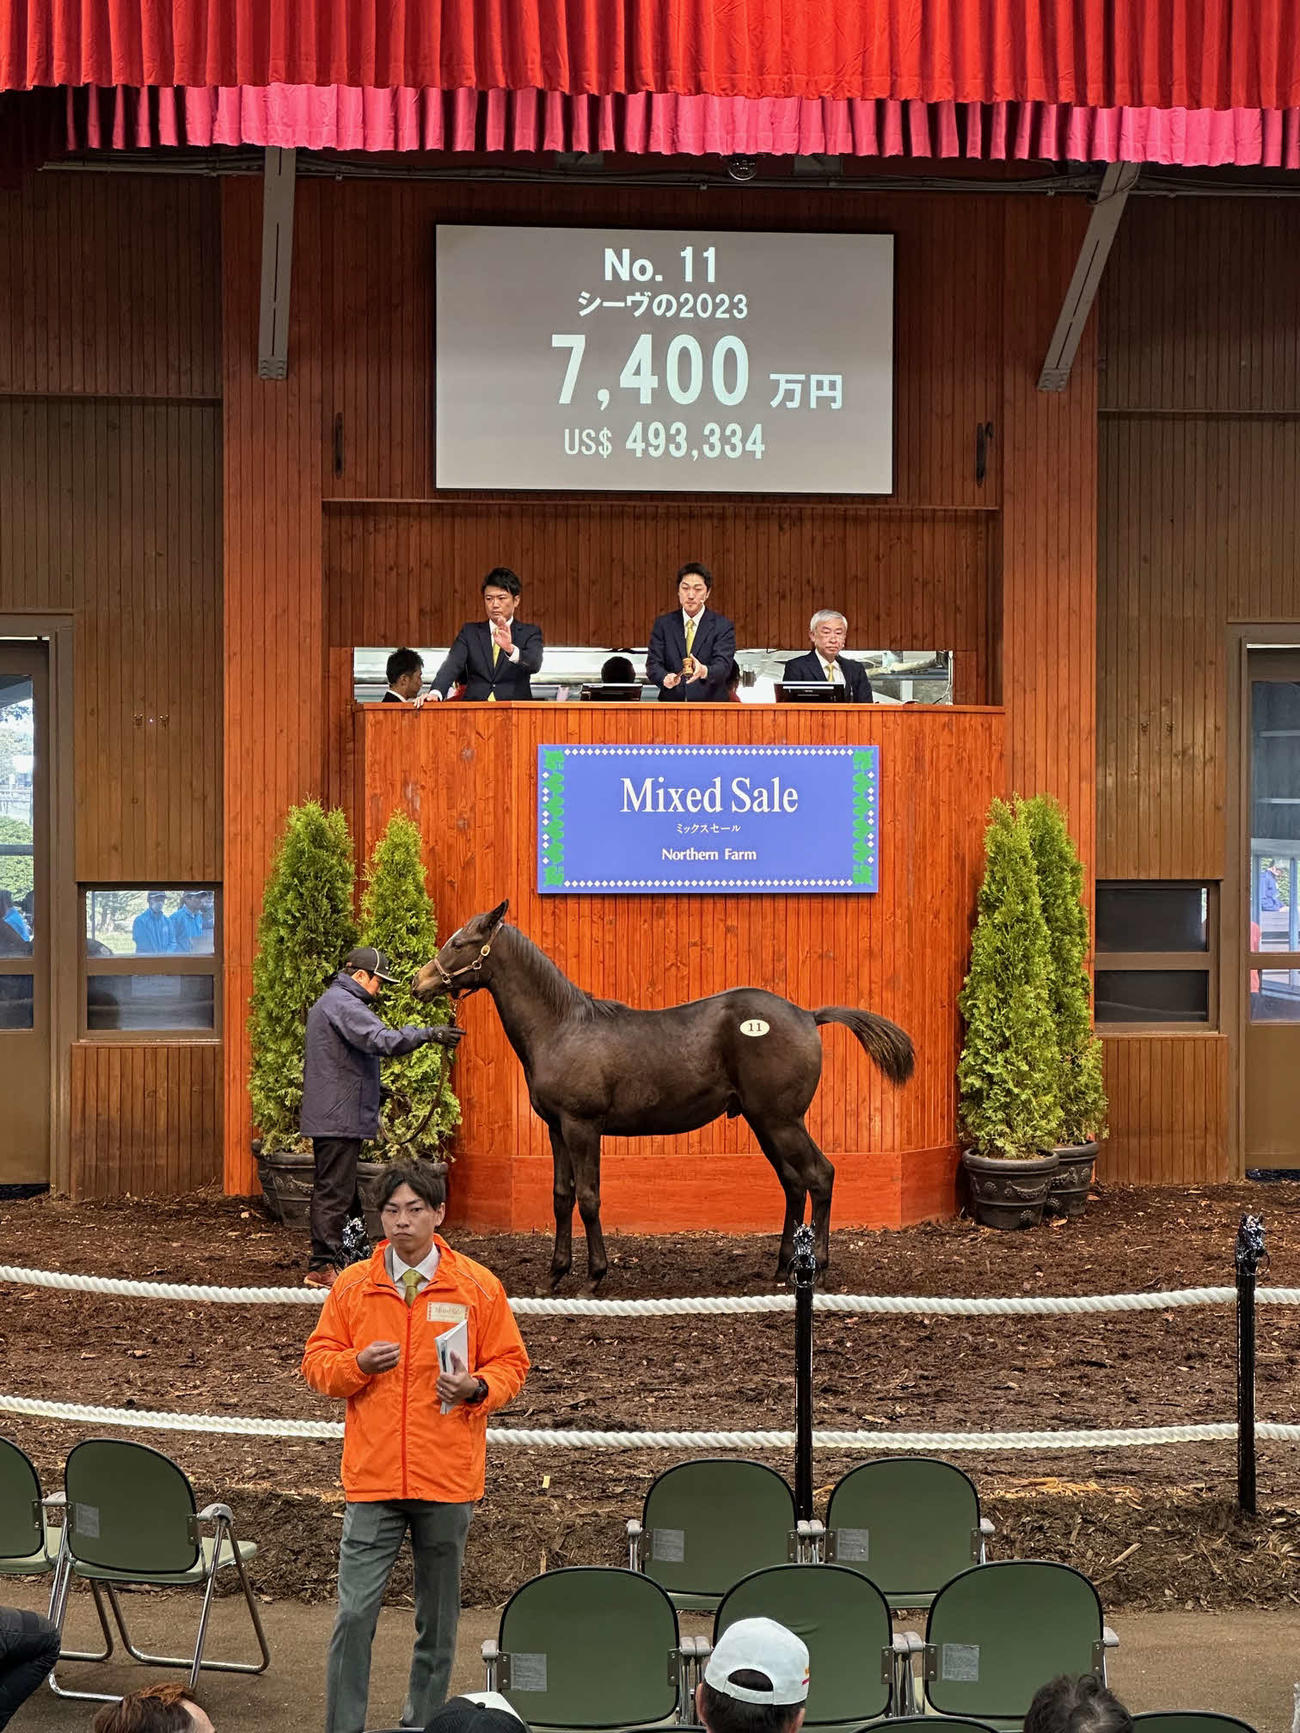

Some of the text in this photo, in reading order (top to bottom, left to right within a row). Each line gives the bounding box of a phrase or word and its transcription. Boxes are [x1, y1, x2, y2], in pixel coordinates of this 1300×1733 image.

[604, 246, 716, 283] No. 11
[577, 291, 749, 319] シーヴの2023
[551, 334, 844, 411] 7,400 万円
[564, 421, 766, 461] US$ 493,334
[620, 776, 799, 813] Mixed Sale
[676, 823, 742, 834] ミックスセール
[661, 847, 757, 861] Northern Farm
[748, 1022, 762, 1032] 11
